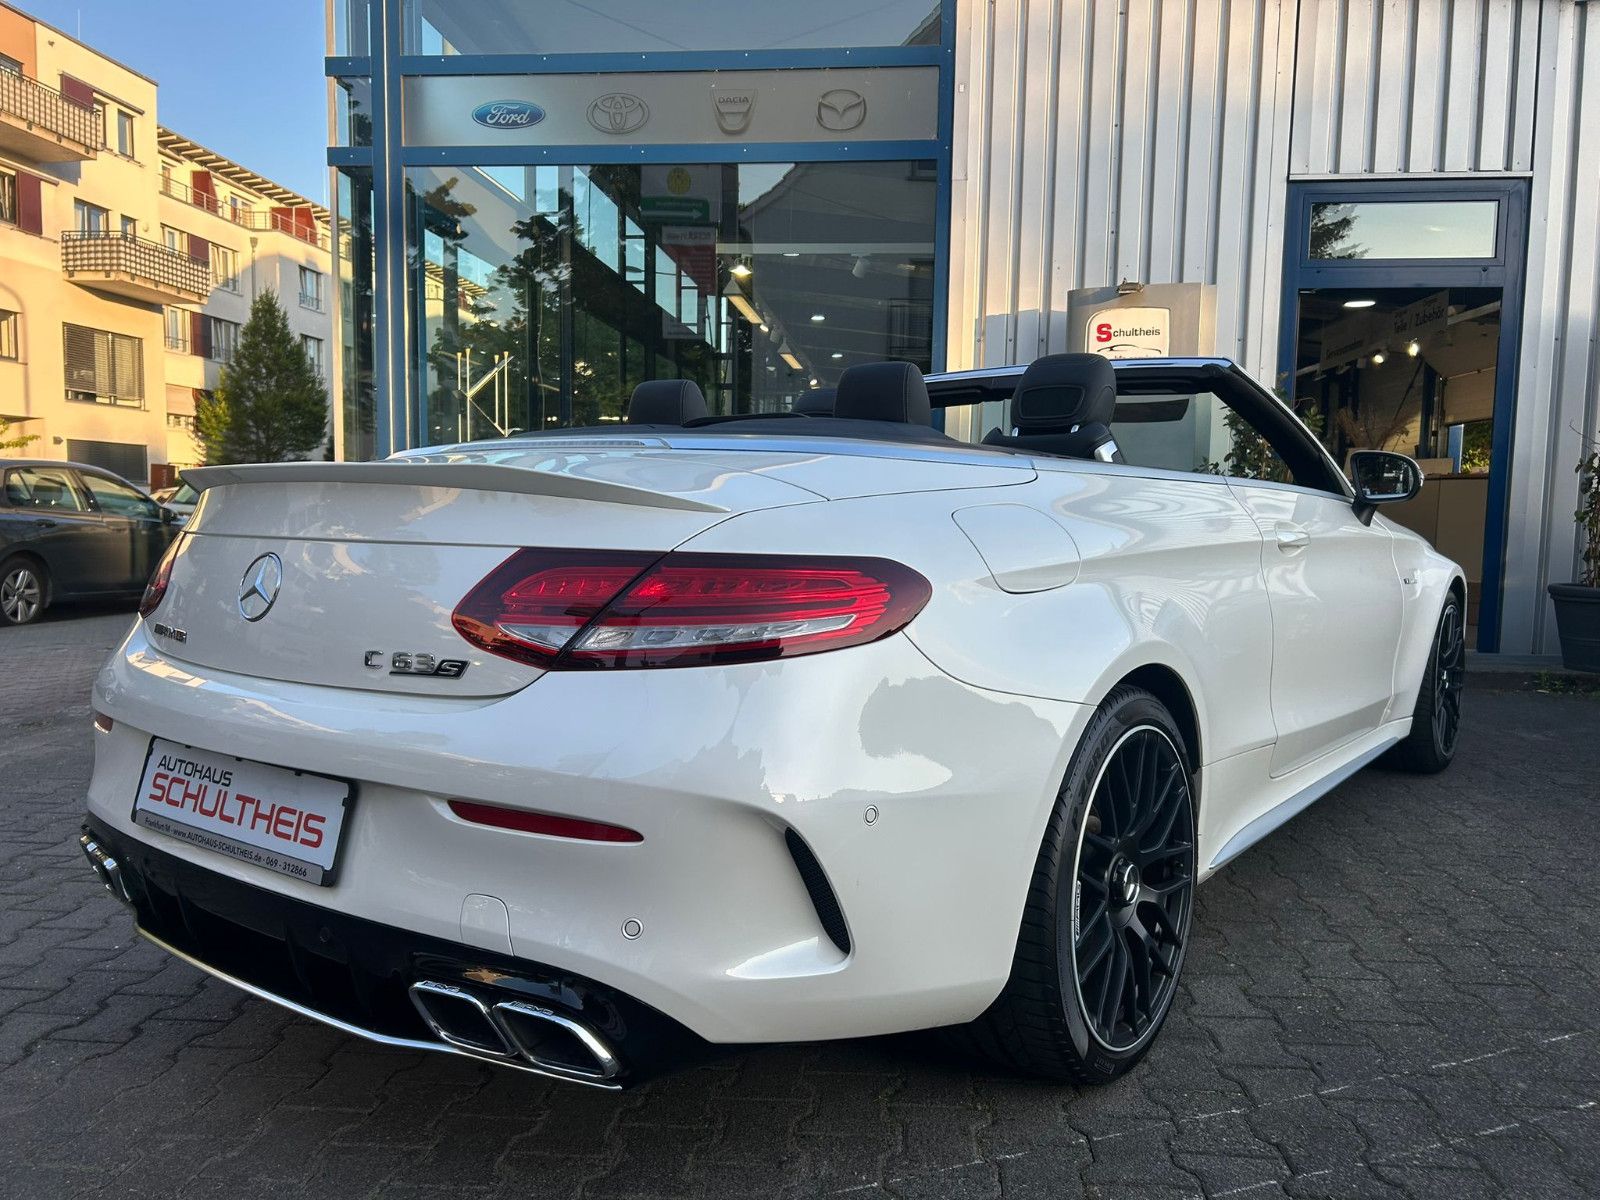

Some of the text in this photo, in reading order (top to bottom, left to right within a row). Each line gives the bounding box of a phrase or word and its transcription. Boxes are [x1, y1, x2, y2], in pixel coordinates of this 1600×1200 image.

[718, 96, 749, 104] DACIA
[486, 103, 530, 124] Ford
[1096, 323, 1161, 342] Schultheis
[364, 650, 384, 670] C
[157, 754, 233, 788] AUTOHAUS
[148, 772, 327, 849] SCHULTHEIS
[265, 856, 279, 868] 069
[282, 861, 307, 877] 312866
